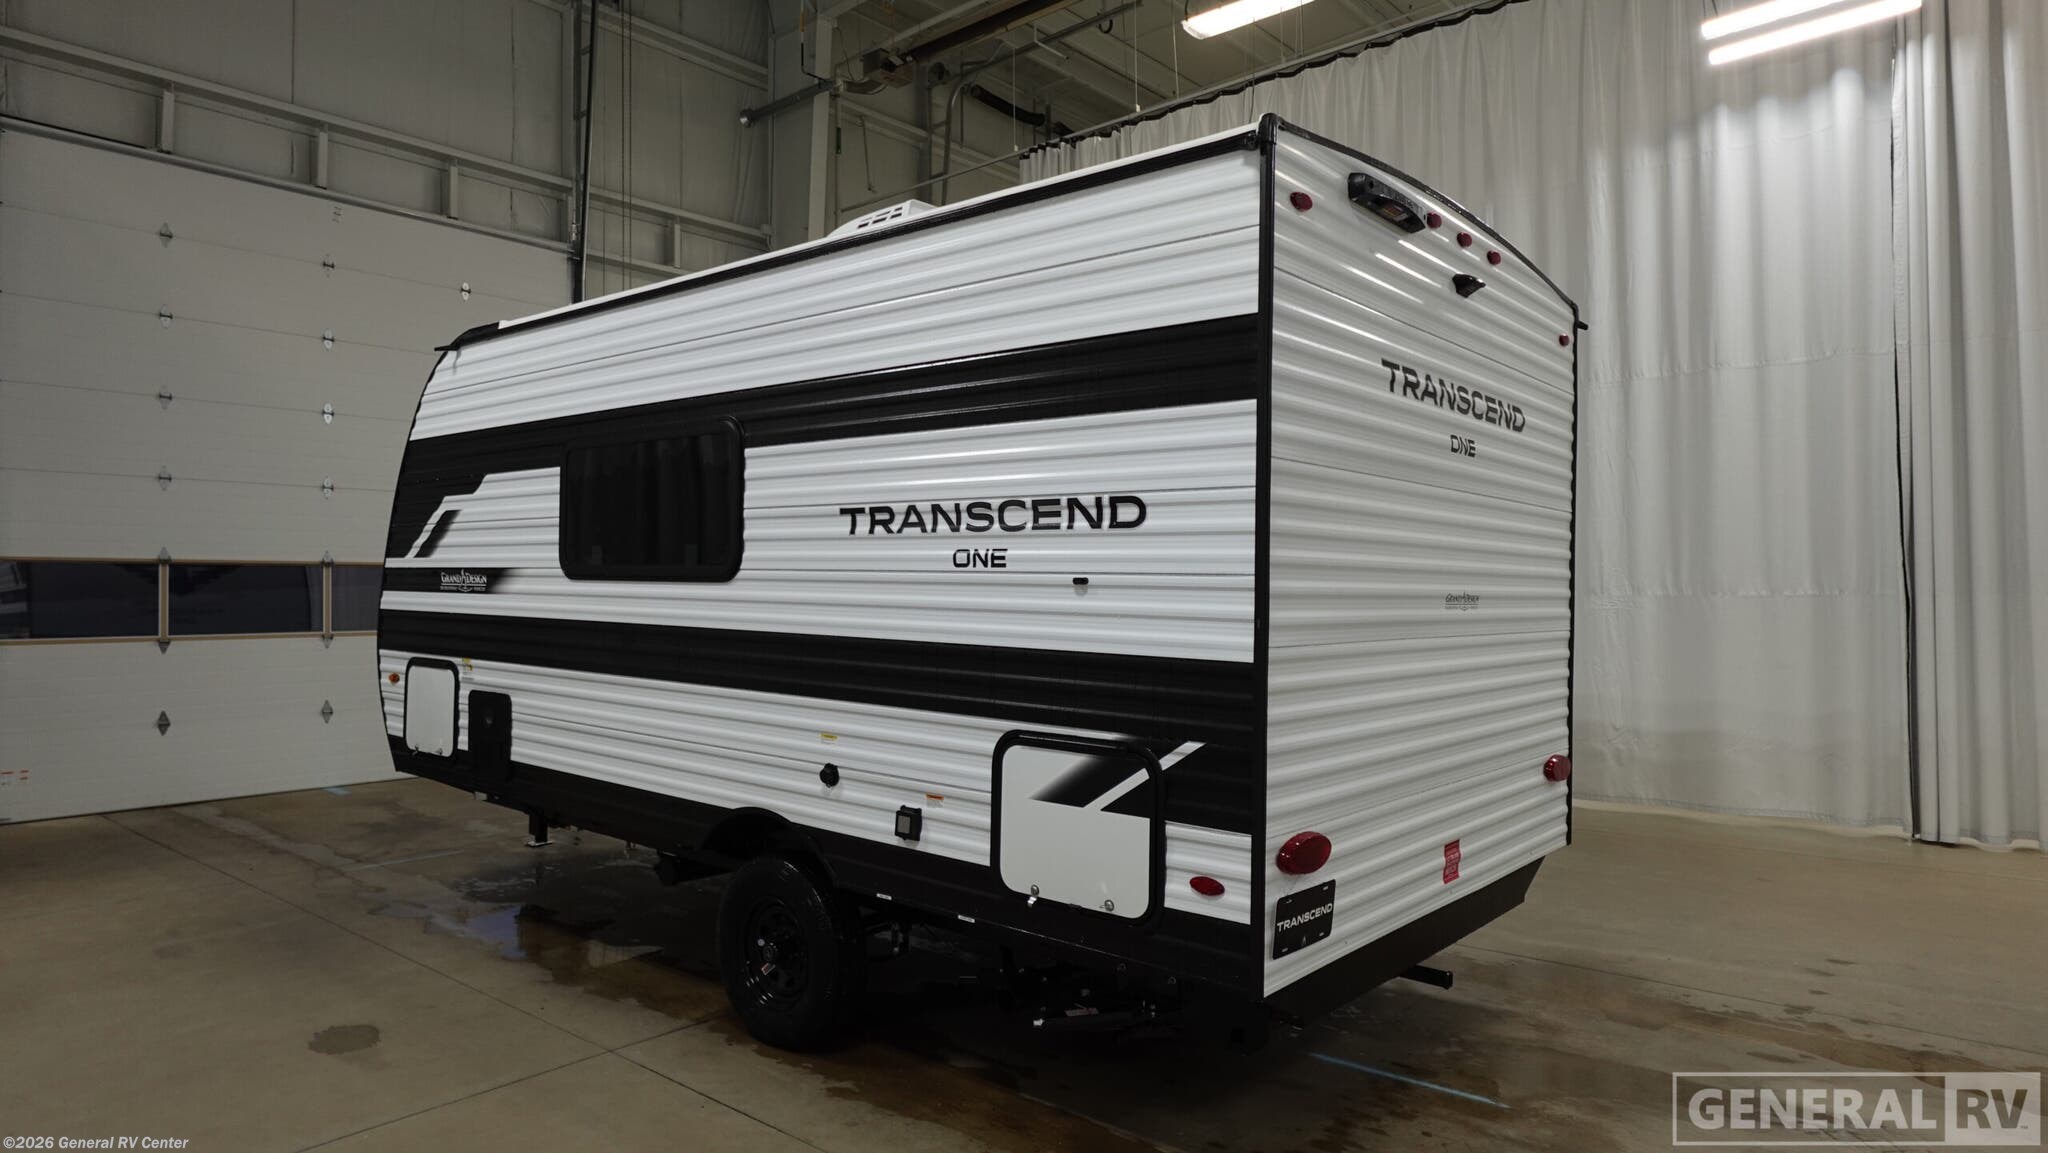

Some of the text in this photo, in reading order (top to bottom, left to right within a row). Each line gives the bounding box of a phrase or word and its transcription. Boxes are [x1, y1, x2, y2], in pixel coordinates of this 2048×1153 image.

[1381, 358, 1526, 433] TRANSCEND
[1450, 434, 1476, 458] ONE
[839, 495, 1147, 536] TRANSCEND
[952, 548, 1008, 569] ONE
[1277, 903, 1333, 932] TRANSCEND
